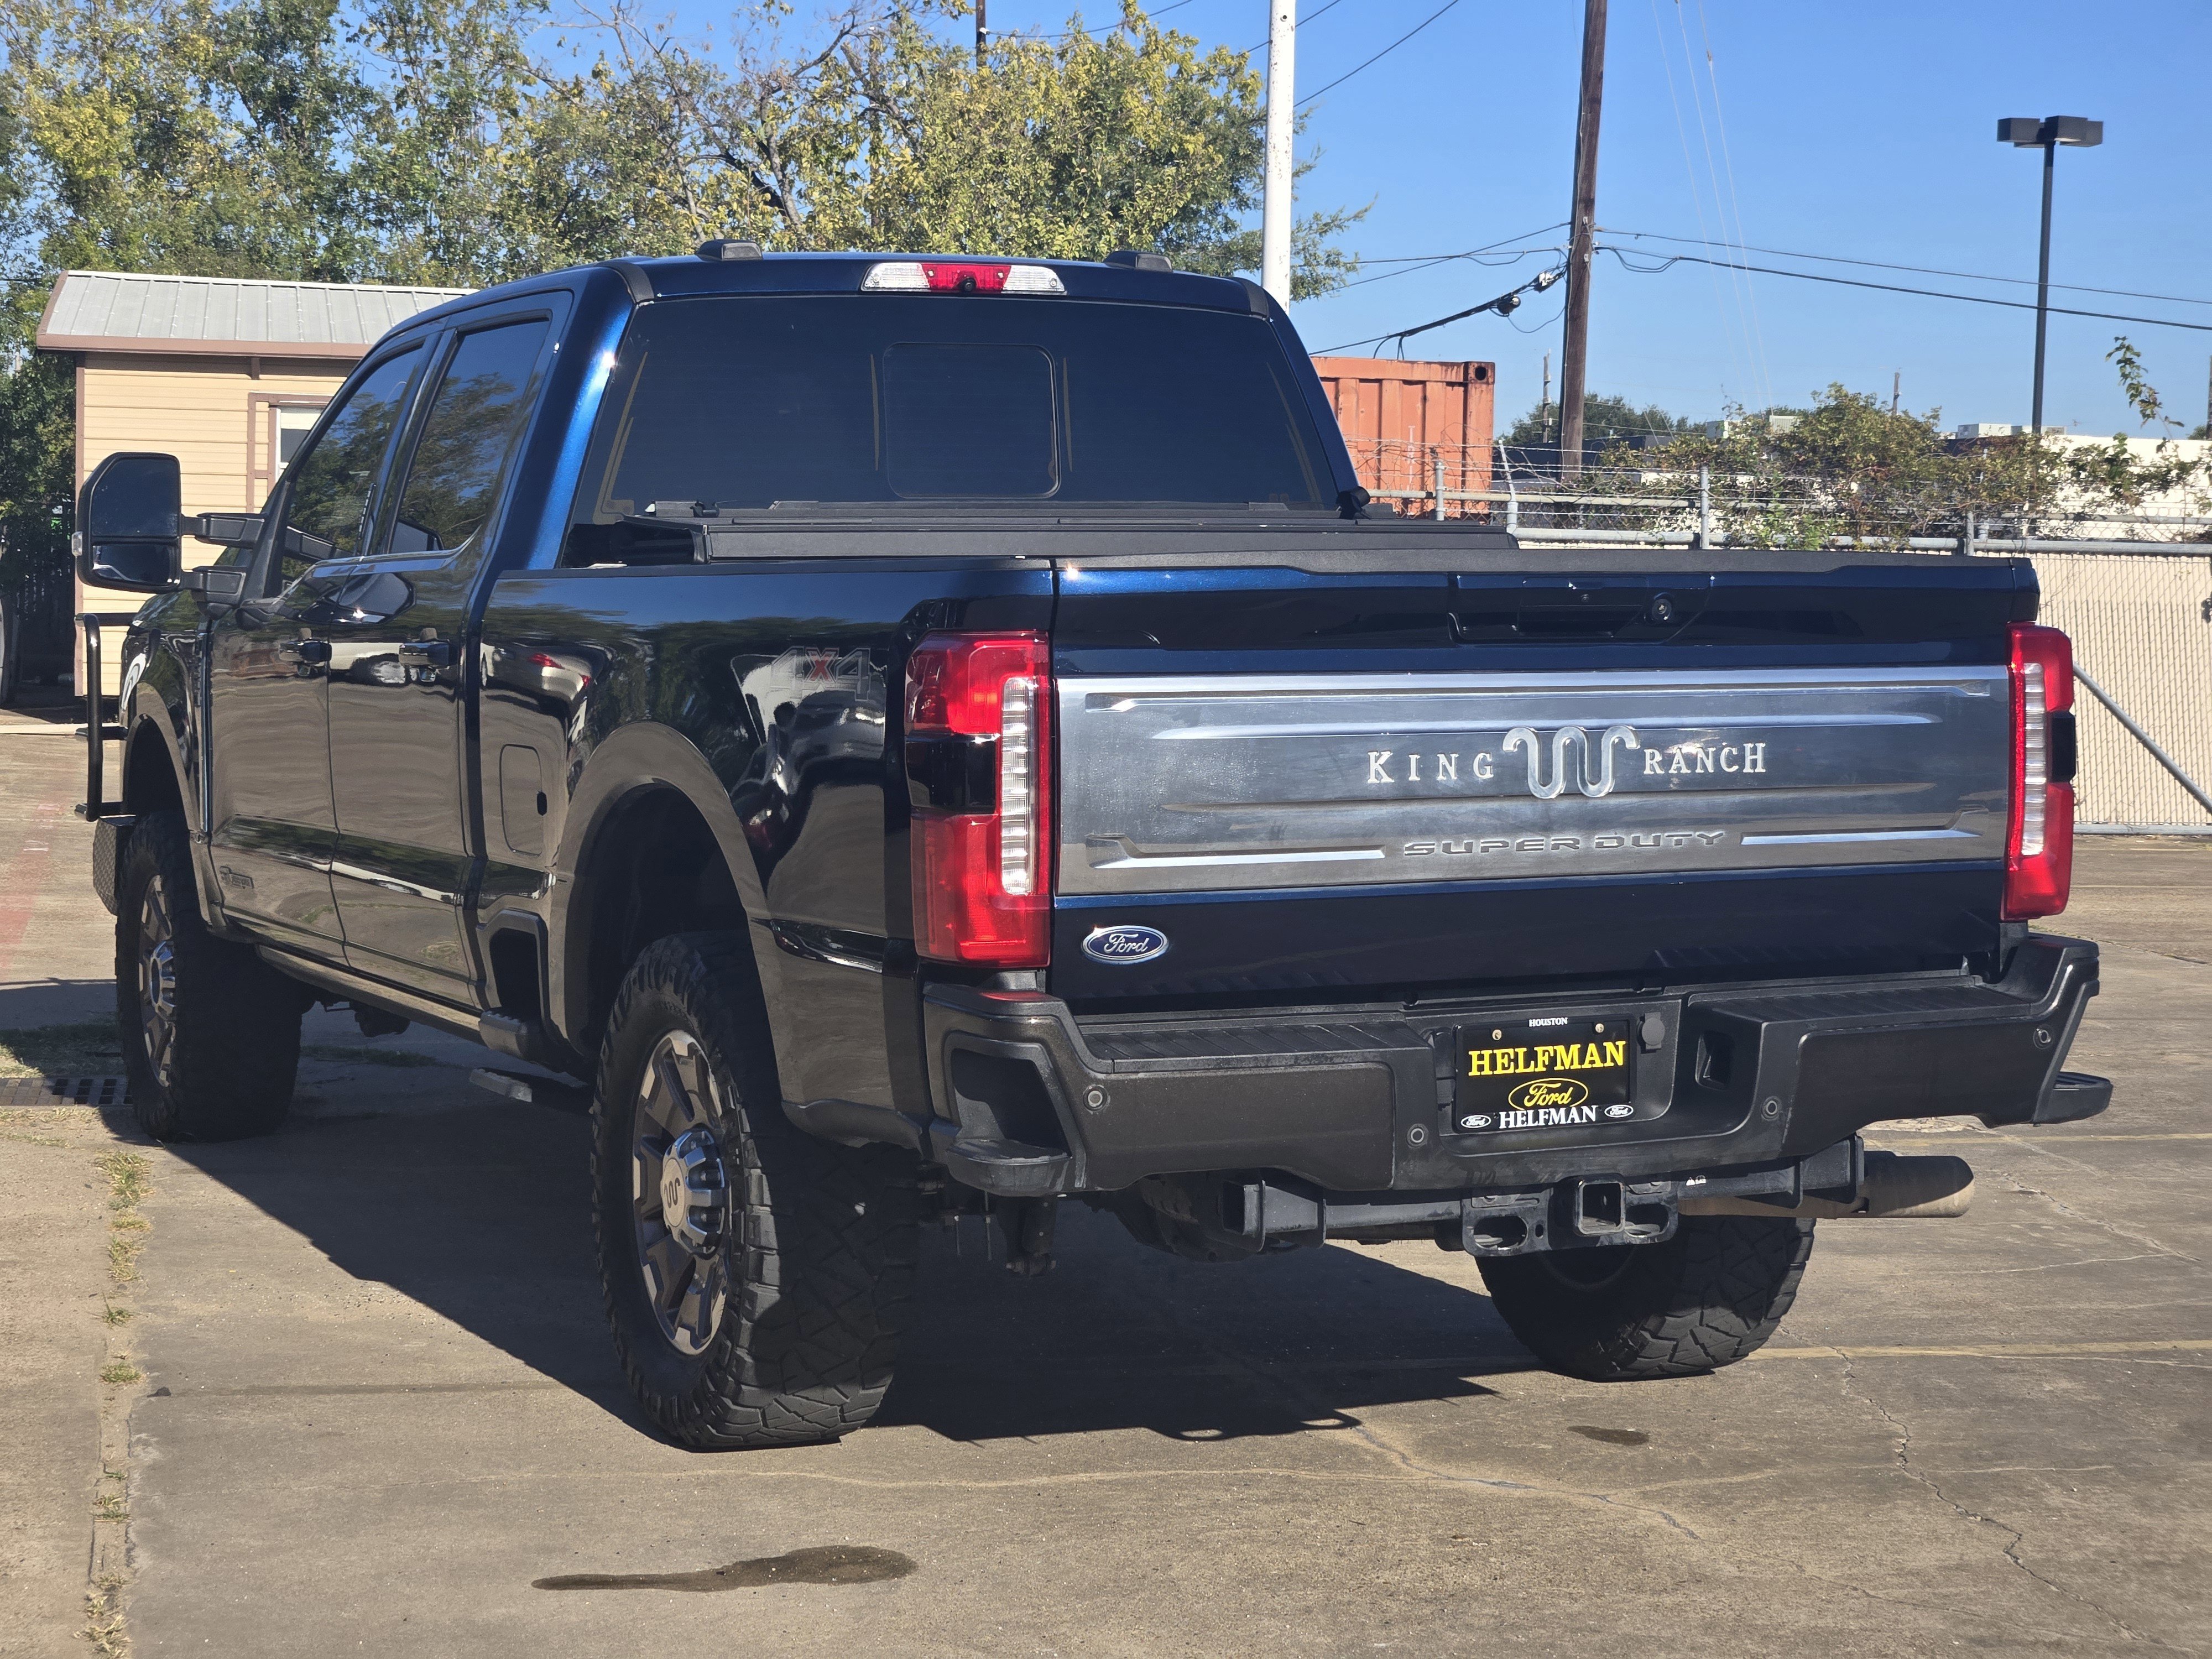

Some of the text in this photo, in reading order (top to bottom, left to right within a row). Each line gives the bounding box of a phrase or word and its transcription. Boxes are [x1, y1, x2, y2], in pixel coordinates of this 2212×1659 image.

[1366, 742, 1768, 784] KING RANCH
[1404, 831, 1725, 857] SUPER DUTY
[1103, 933, 1150, 953] Ford
[1528, 1017, 1568, 1027] HOUSTON
[1468, 1040, 1626, 1076] HELFMAN
[1523, 1082, 1573, 1107] Ford
[1499, 1104, 1599, 1129] HELFMAN
